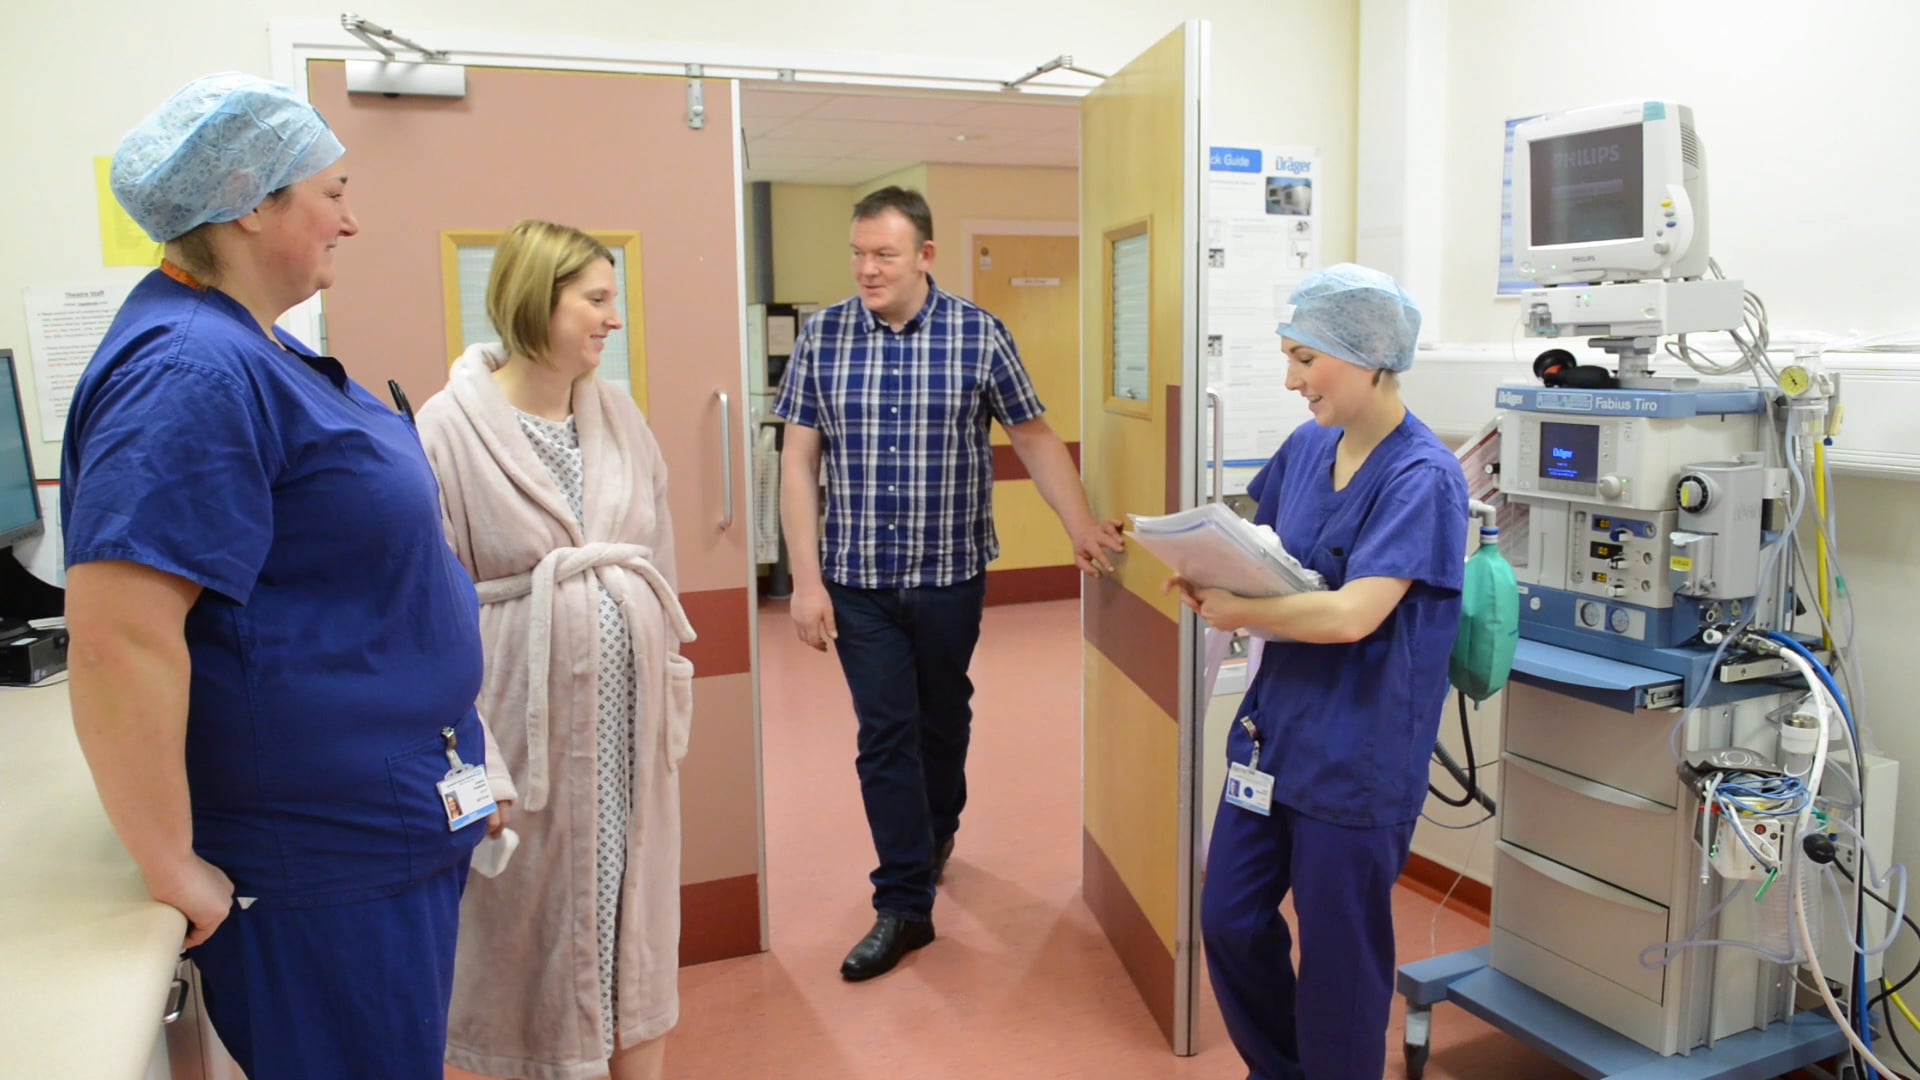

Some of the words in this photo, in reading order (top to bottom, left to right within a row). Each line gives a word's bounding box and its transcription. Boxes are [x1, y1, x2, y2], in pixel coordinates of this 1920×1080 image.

[1224, 153, 1250, 167] Guide
[1553, 144, 1620, 168] PHILIPS
[1595, 397, 1631, 411] Fabius
[1634, 398, 1658, 411] Tiro
